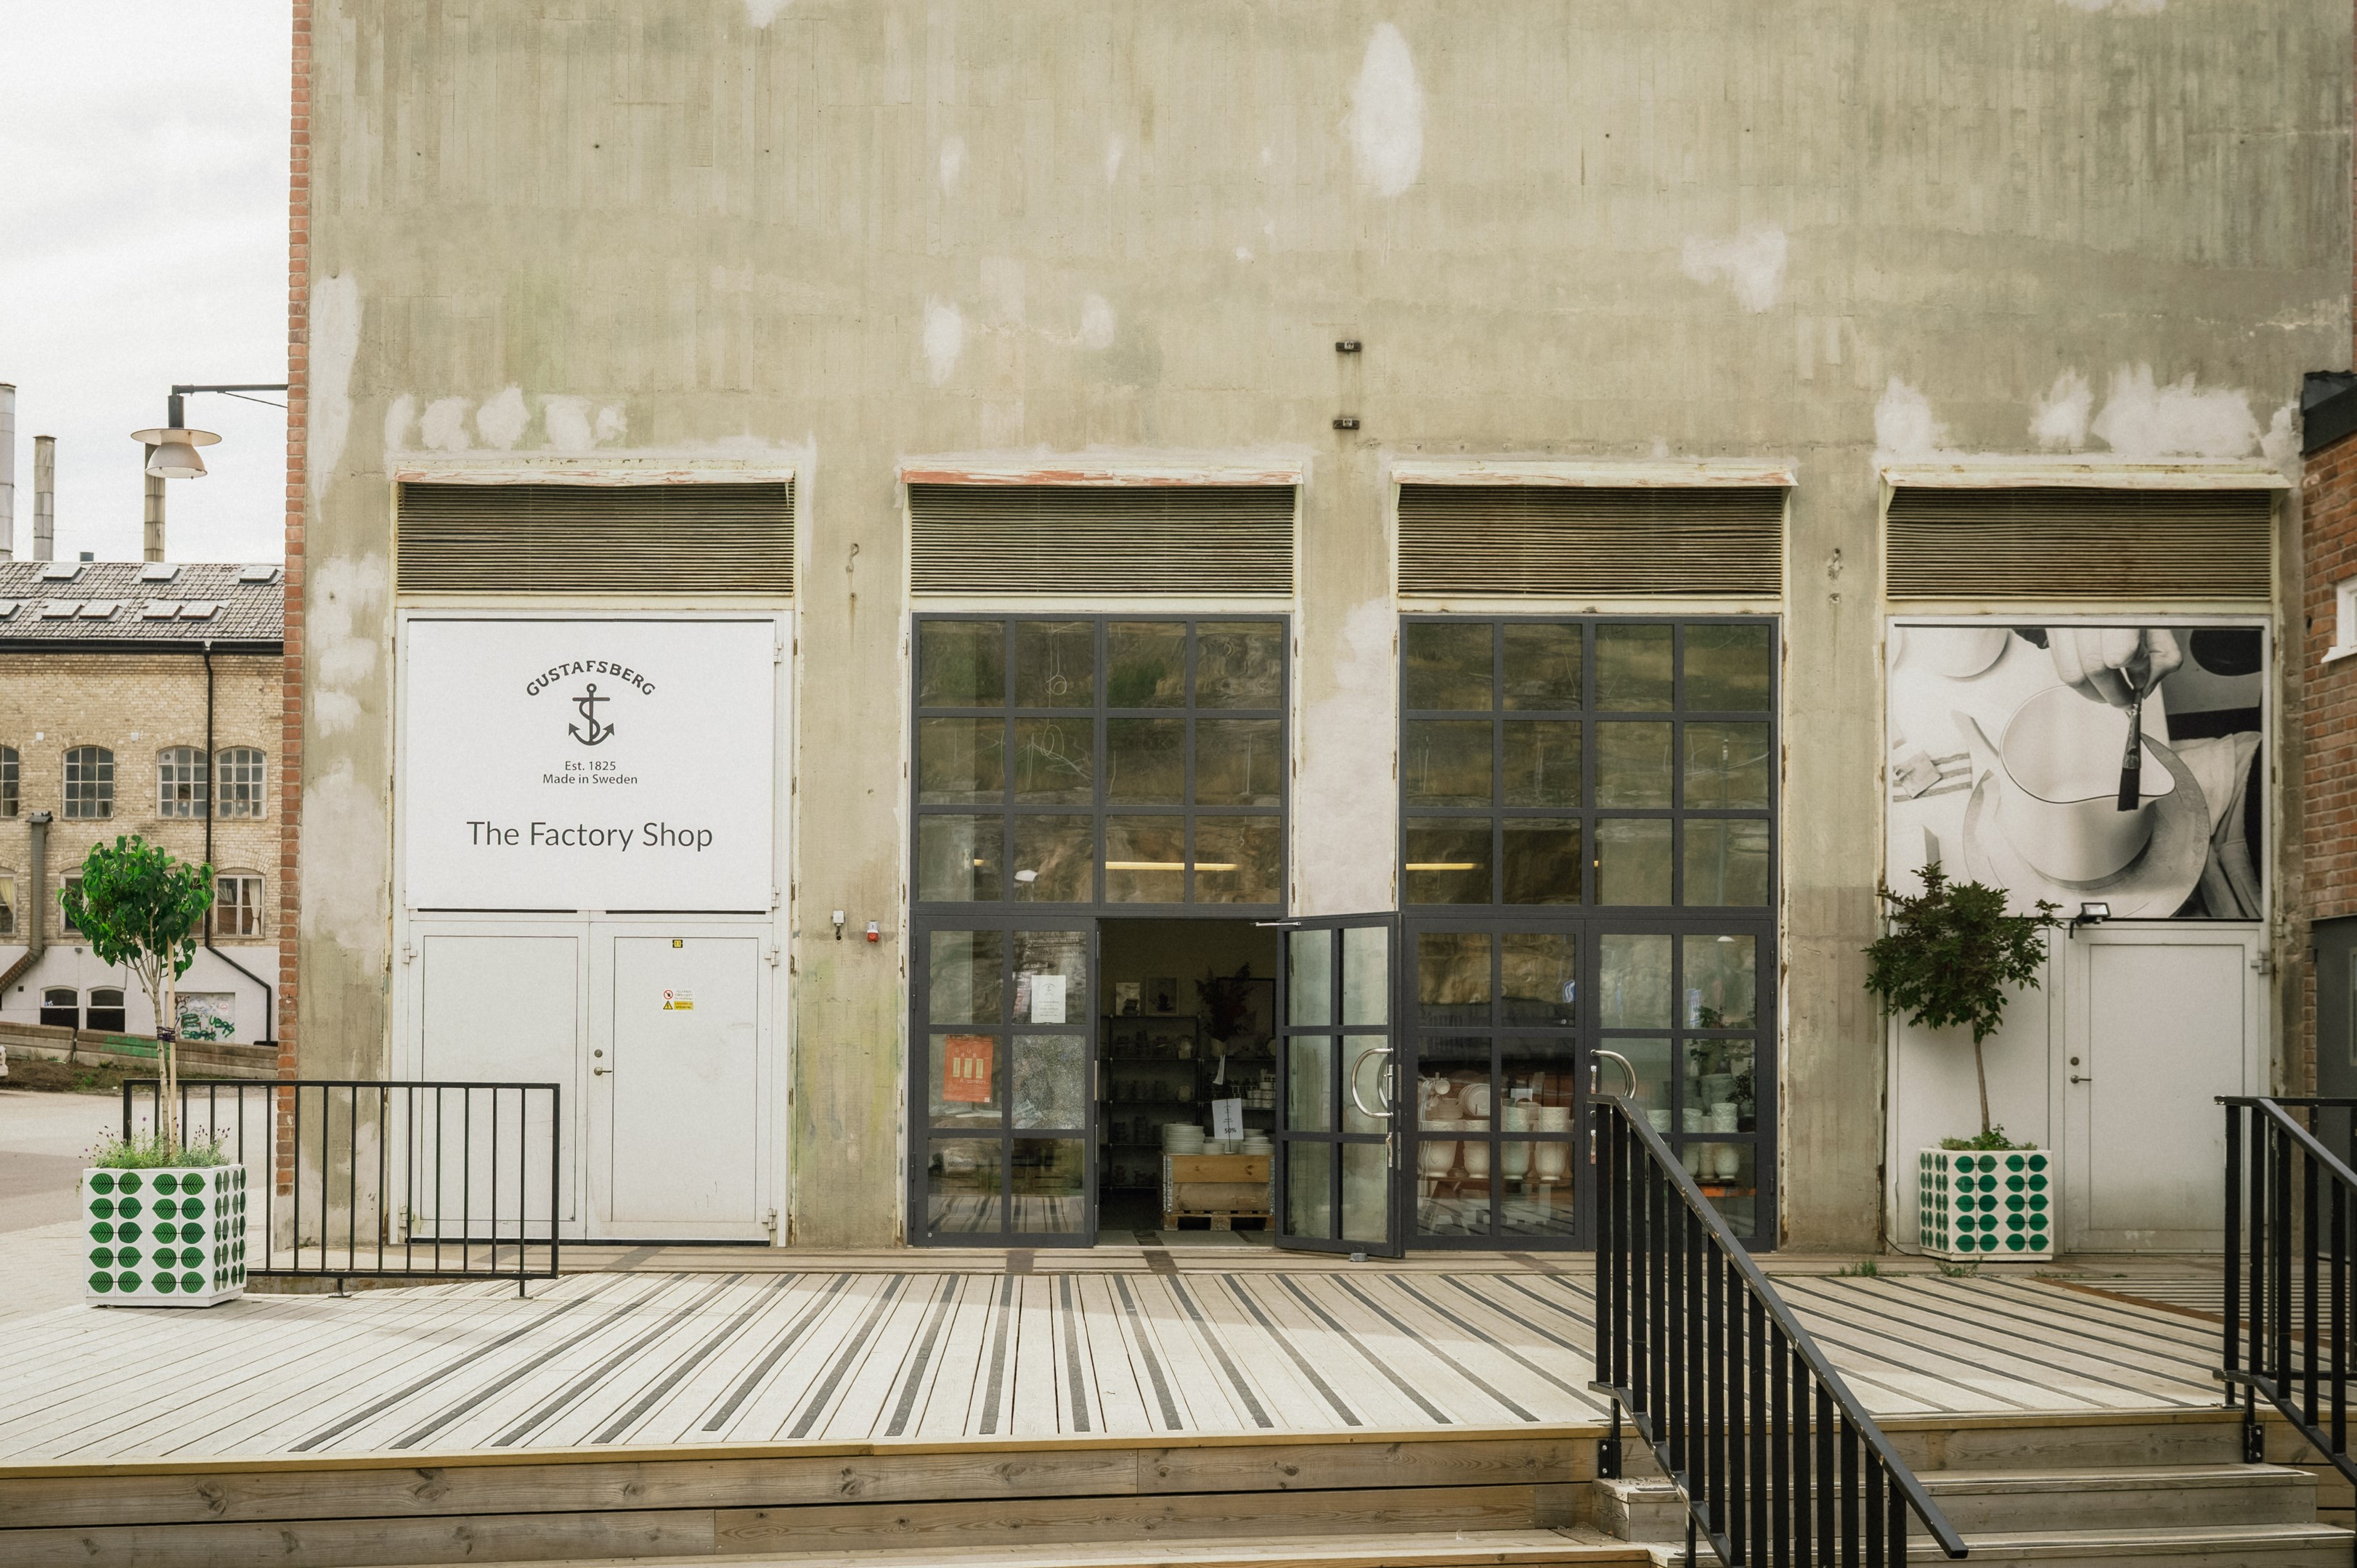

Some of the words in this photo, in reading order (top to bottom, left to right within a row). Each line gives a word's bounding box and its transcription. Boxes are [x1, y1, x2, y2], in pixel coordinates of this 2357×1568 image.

[526, 660, 656, 696] GUSTAFSBERG
[565, 761, 585, 771] Est.
[589, 761, 616, 771] 1825
[542, 773, 576, 784] Made
[579, 774, 589, 784] in
[592, 774, 638, 785] Sweden
[466, 820, 519, 846] The
[531, 821, 634, 852] Factory
[643, 822, 713, 852] Shop
